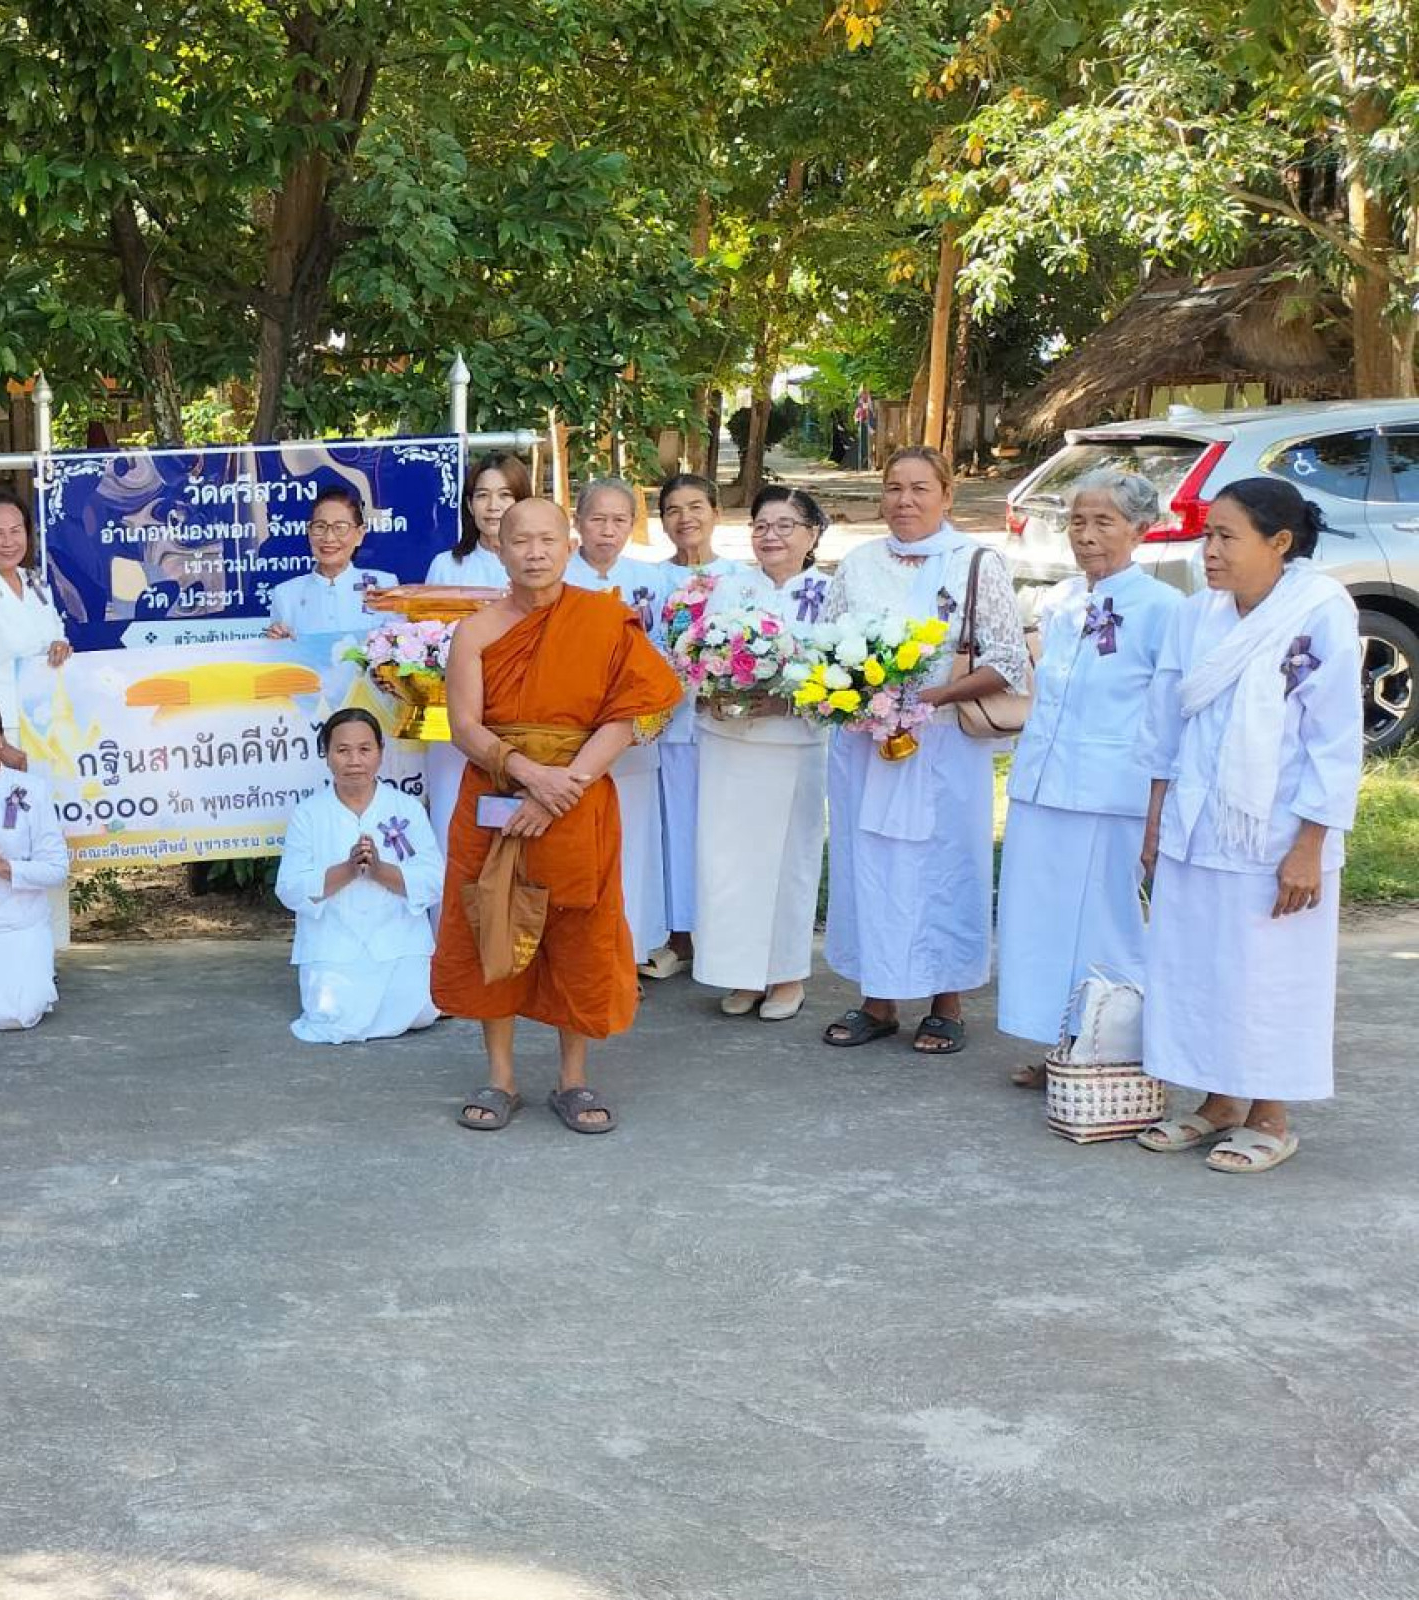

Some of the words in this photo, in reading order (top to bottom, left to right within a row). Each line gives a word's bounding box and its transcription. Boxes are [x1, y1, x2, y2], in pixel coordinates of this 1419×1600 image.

[184, 475, 318, 505] วัดศรีสว่าง
[100, 520, 257, 544] อำเภอหนองพอก
[142, 586, 169, 609] วัด
[179, 586, 245, 609] ประชา
[77, 716, 328, 787] กฐินสามัคคีทั่วไ
[168, 790, 193, 814] วัด
